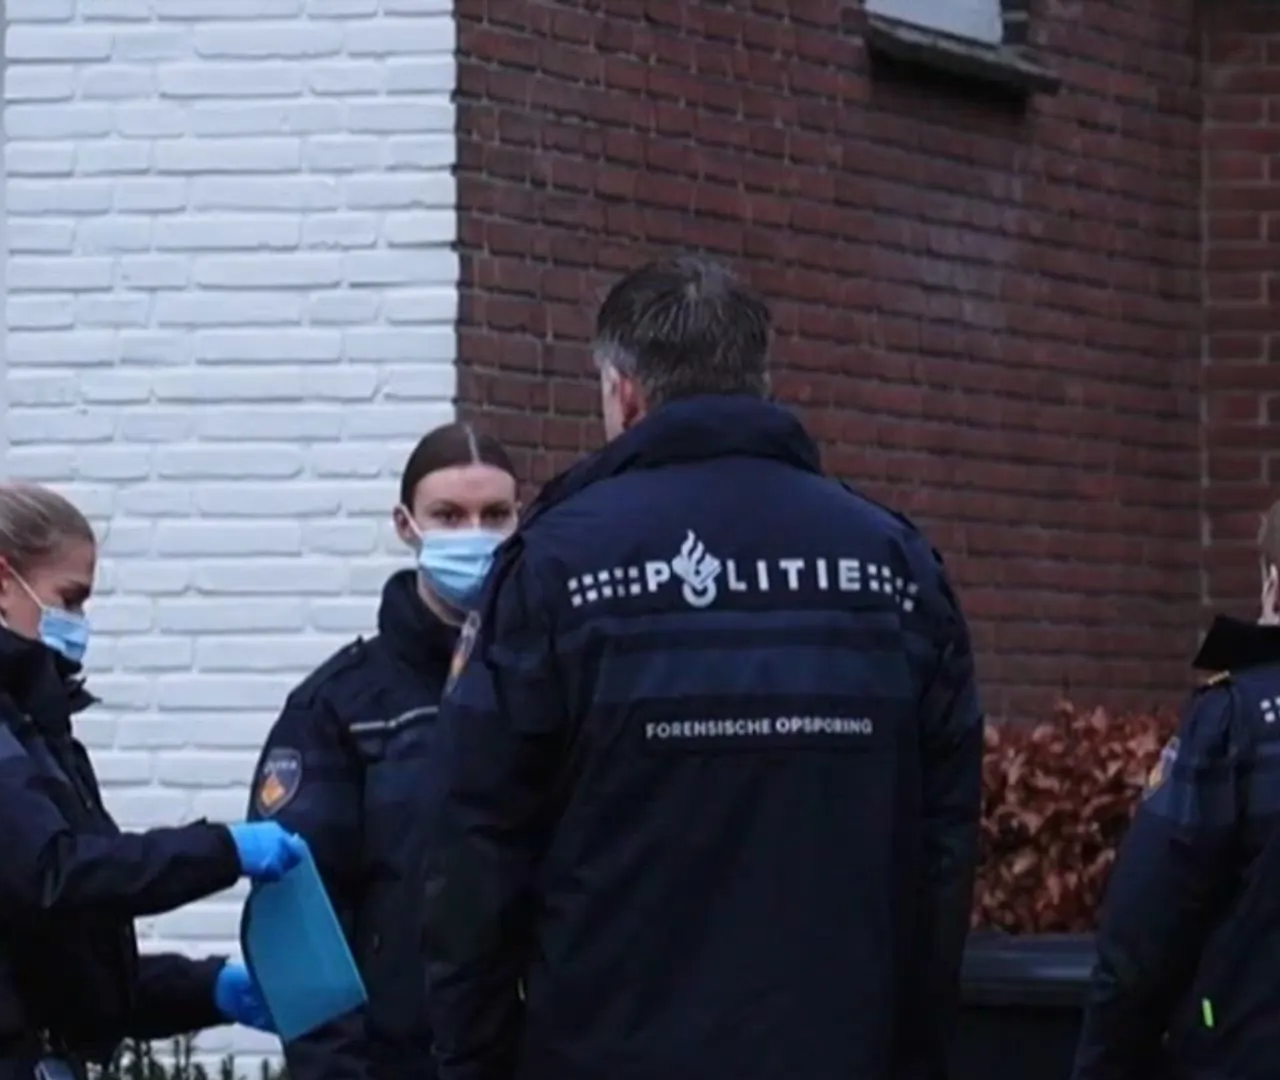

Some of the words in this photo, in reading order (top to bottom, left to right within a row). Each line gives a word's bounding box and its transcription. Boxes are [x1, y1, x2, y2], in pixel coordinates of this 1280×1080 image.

[645, 548, 861, 608] POLITIE
[646, 719, 771, 738] FORENSISCHE
[776, 717, 872, 734] OPSPORING
